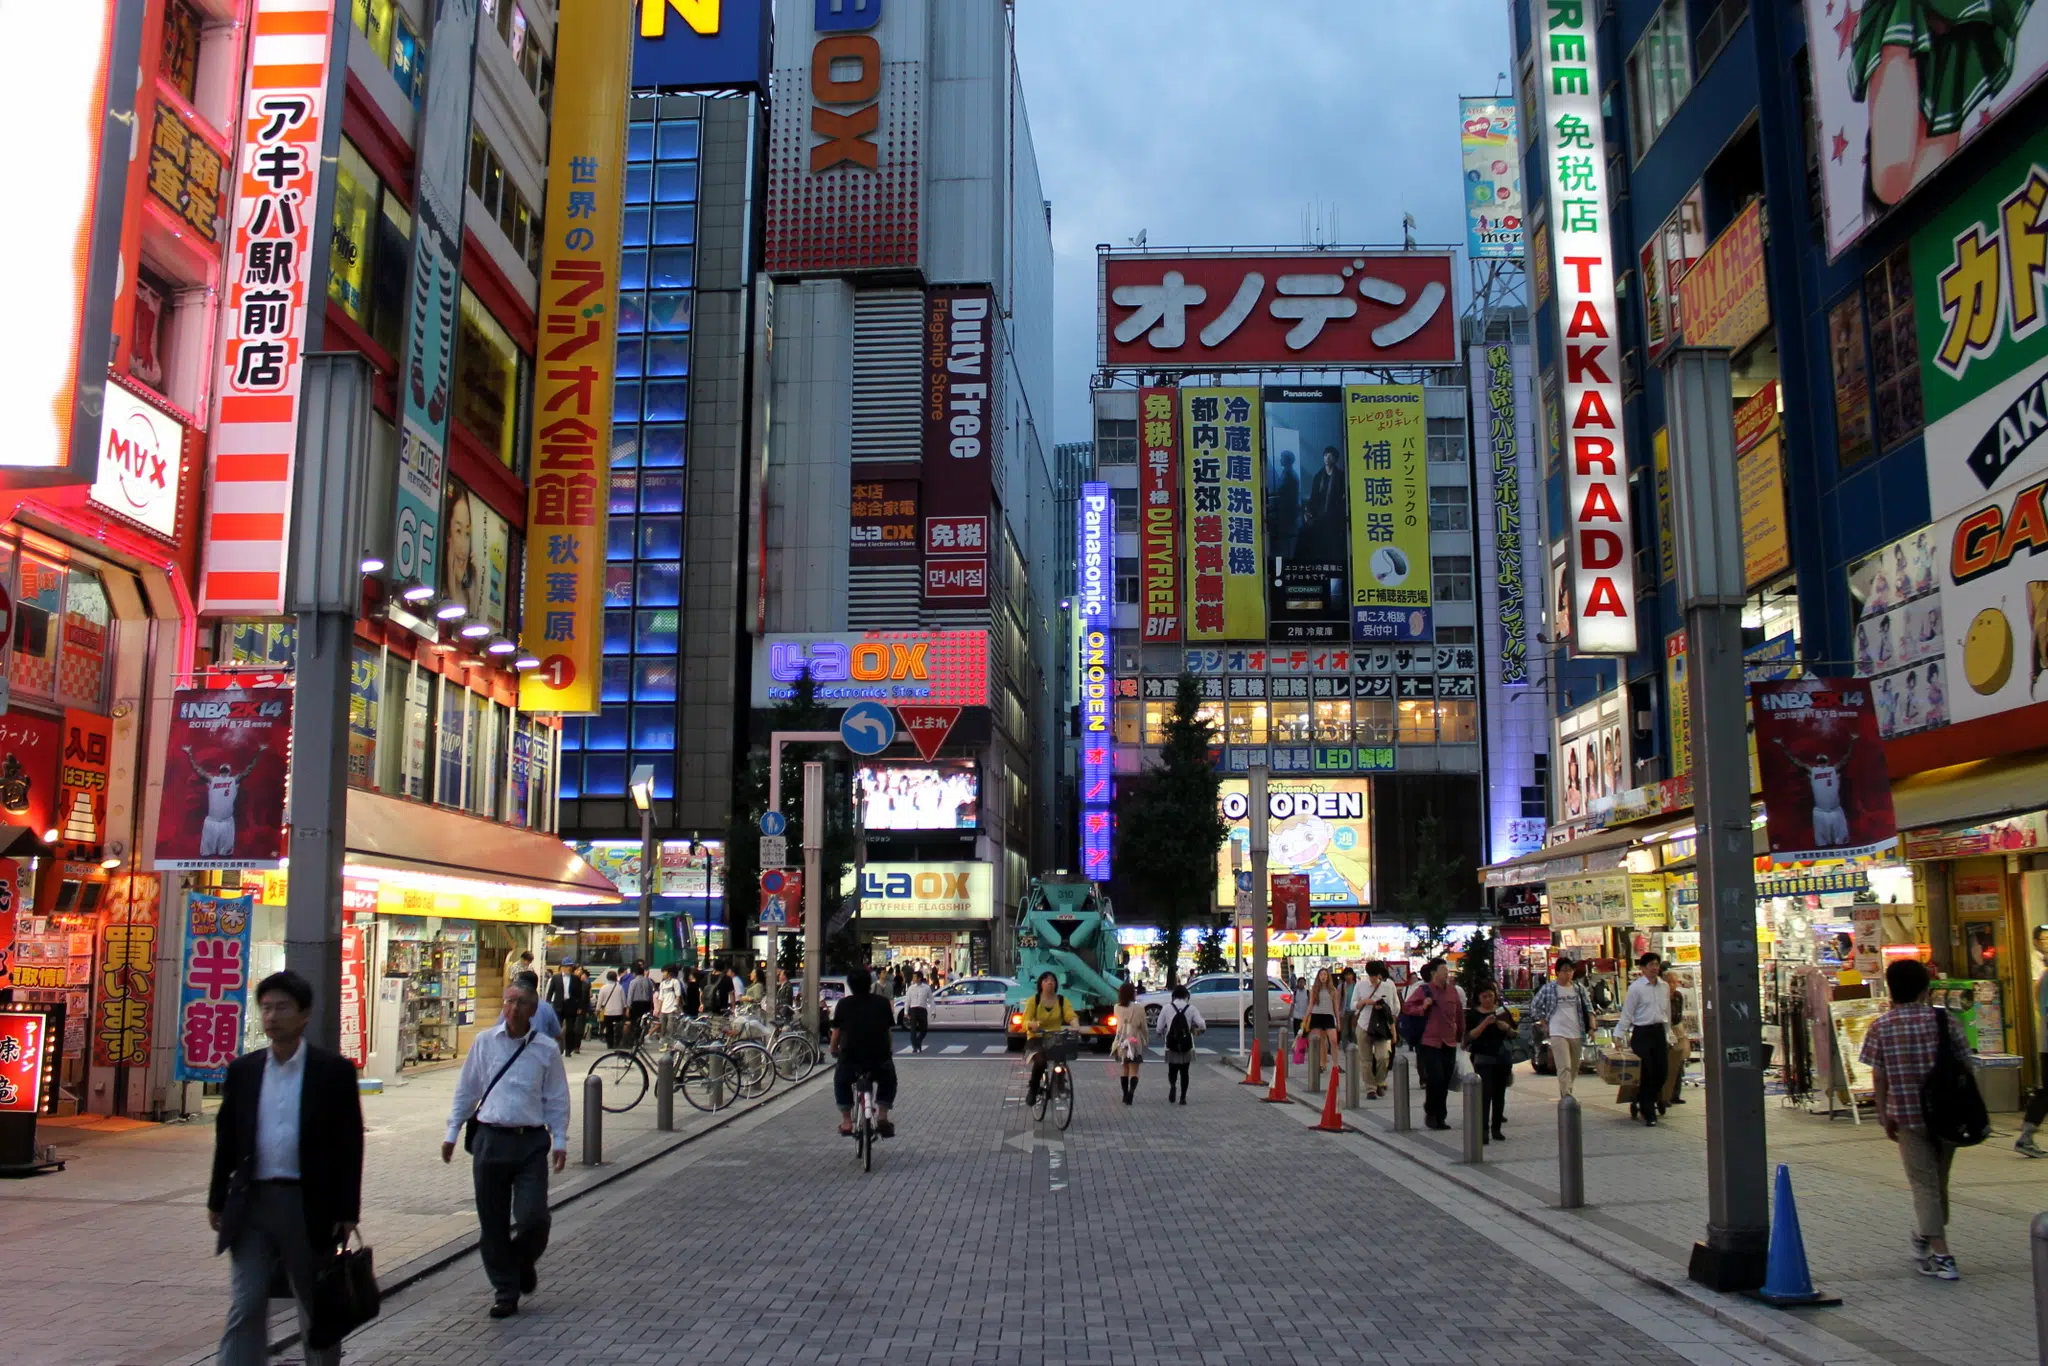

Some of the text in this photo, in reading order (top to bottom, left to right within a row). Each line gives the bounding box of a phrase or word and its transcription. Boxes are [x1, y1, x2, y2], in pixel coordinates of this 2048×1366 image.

[1554, 112, 1599, 235] 免税店
[565, 156, 598, 254] 世界の
[237, 102, 306, 386] アキバ駅前店
[1938, 174, 2048, 370] カド
[1112, 259, 1446, 350] オノデン
[929, 299, 948, 420] Flagship Store
[946, 298, 987, 459] Duty Free
[534, 260, 605, 527] ラジオ会館
[1283, 390, 1323, 398] Panasonic
[1350, 409, 1404, 425] テレビの音も
[1351, 392, 1420, 403] Panasonic
[1144, 394, 1173, 448] 免税
[1377, 415, 1420, 431] よりキレイ
[1563, 257, 1628, 618] TAKARADA
[852, 484, 883, 499] 本店
[852, 501, 915, 516] 総合家電
[1223, 396, 1255, 575] 冷蔵庫 洗濯機
[1362, 440, 1394, 543] 補聴器
[397, 506, 435, 583] 6F
[931, 524, 982, 547] 免税
[1083, 495, 1105, 616] Panasonic
[1147, 508, 1175, 615] DUTYFREE
[543, 533, 581, 643] 秋葉原
[929, 569, 982, 587] 면세점
[1357, 589, 1428, 604] 2F補聴器売場
[1146, 618, 1177, 636] B1F
[1306, 627, 1333, 636] 冷蔵庫
[1357, 611, 1406, 622] 聞こえ相談
[1363, 623, 1398, 636] 受付中!
[1088, 632, 1106, 732] ONODEN
[65, 727, 107, 765] 入口
[911, 716, 949, 729] 止まれ
[63, 766, 107, 791] はコチラ
[1085, 747, 1107, 866] オノデン
[1223, 792, 1363, 819] OODEN
[918, 903, 972, 911] FLAGSHIP
[1058, 890, 1073, 899] 310
[1284, 944, 1325, 956] ONODEN
[100, 925, 155, 1064] 買います。
[183, 940, 242, 1066] 半額
[21, 1021, 37, 1073] ラーメン
